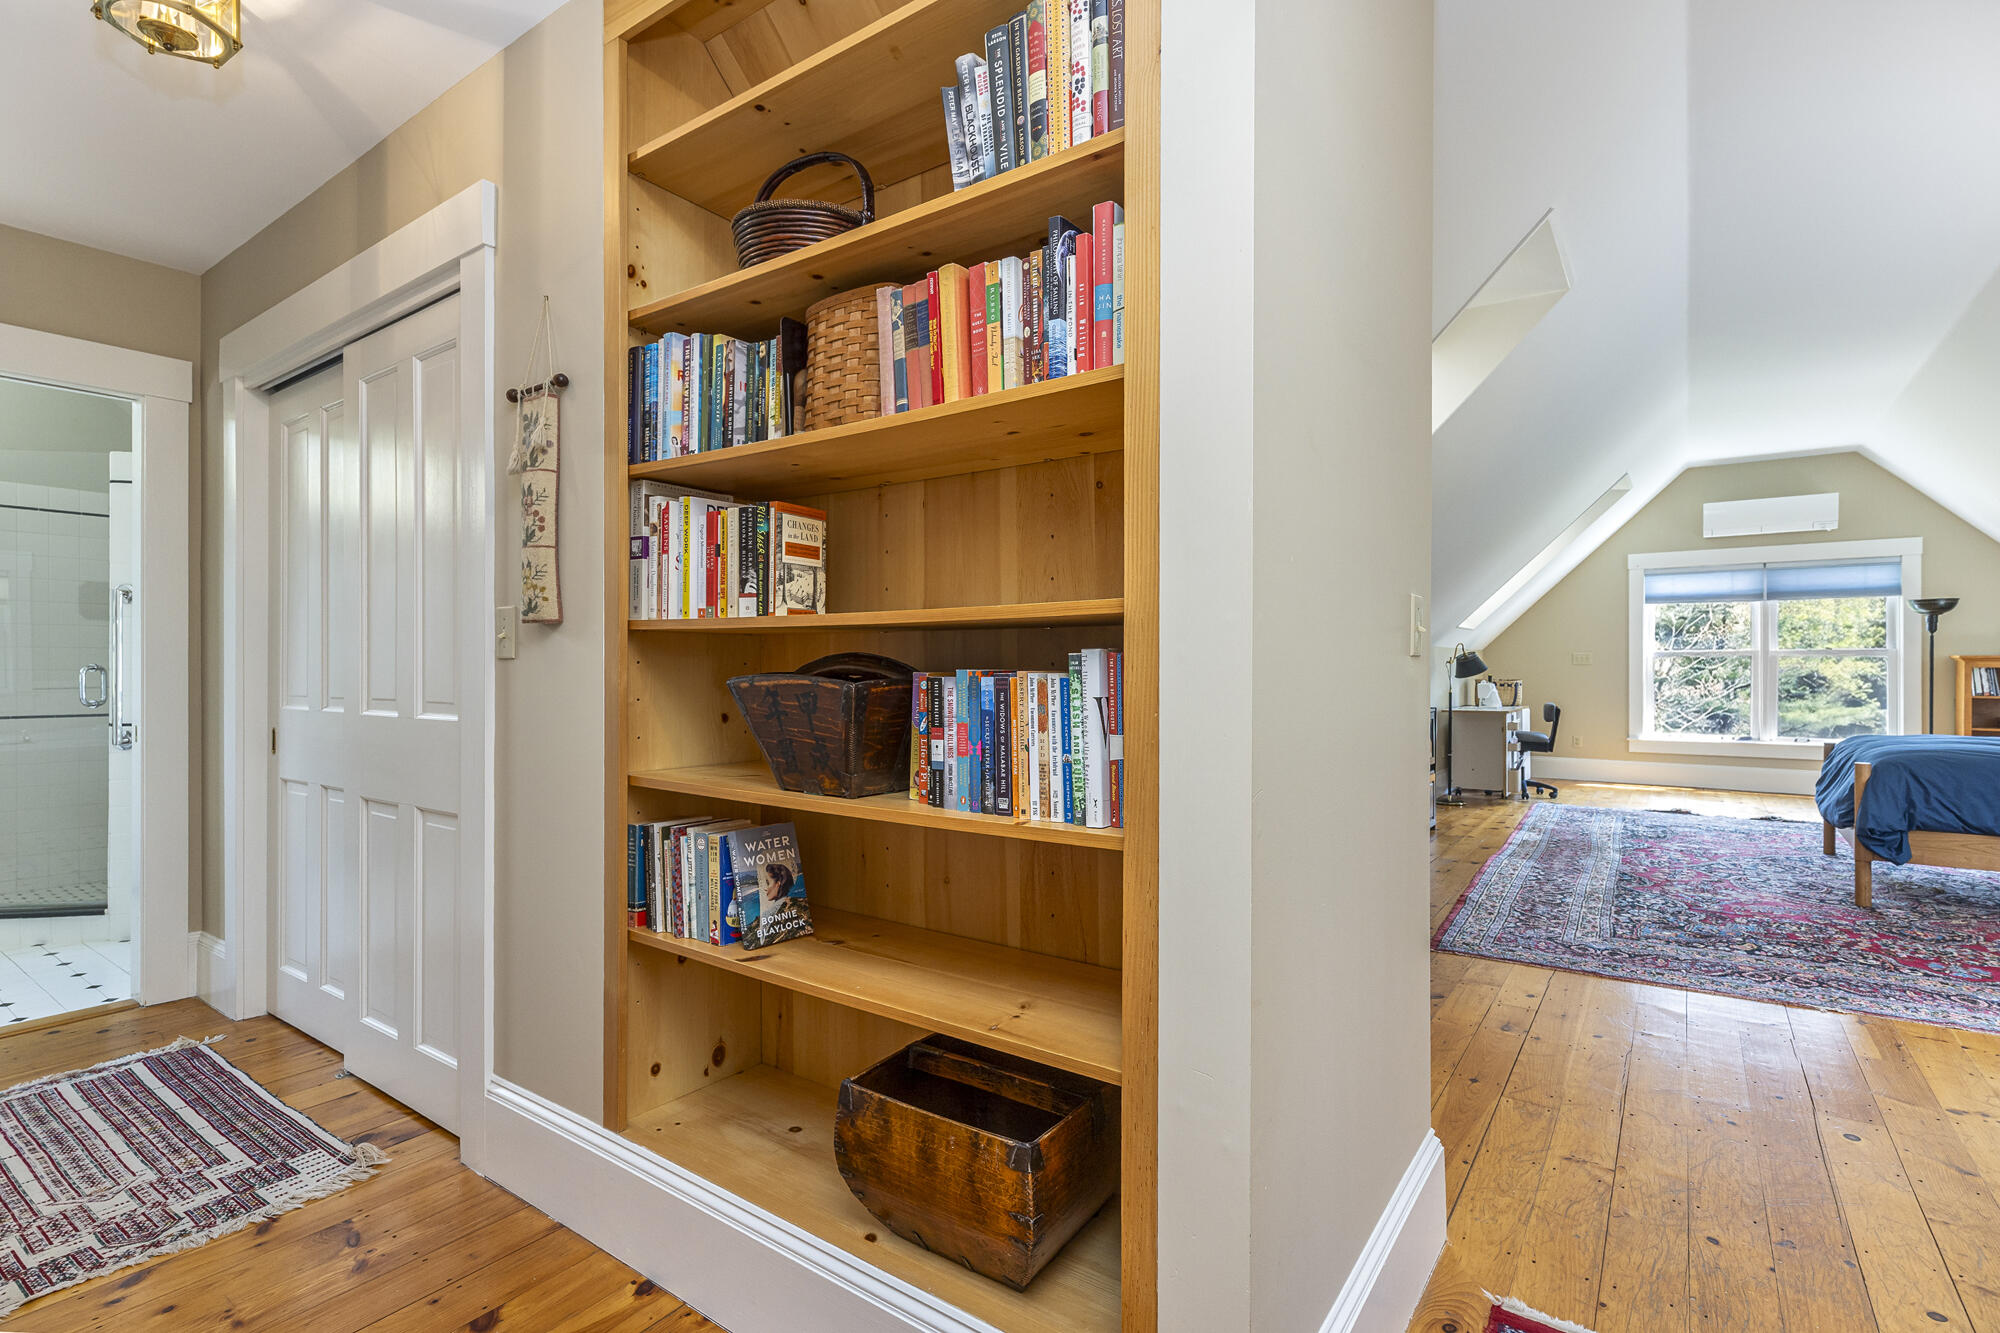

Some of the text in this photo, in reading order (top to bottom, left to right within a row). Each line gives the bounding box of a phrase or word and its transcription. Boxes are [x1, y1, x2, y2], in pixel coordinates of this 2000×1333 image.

[1014, 22, 1020, 30] IN
[1112, 9, 1123, 59] LOST ART
[988, 36, 1007, 46] LARSON
[961, 60, 970, 86] PETER
[1016, 77, 1022, 87] OF
[994, 59, 1006, 117] SPLENDID
[965, 104, 980, 176] BLACKHOUSE
[999, 143, 1009, 170] VILE
[1052, 276, 1059, 286] OF
[1097, 302, 1112, 310] JIN
[757, 506, 766, 554] RILEY SAGER
[787, 519, 820, 533] CHANGES
[800, 531, 819, 543] LAND
[946, 698, 954, 732] SNOWDONIA
[1070, 687, 1083, 793] SLASH AND BURN
[920, 738, 928, 782] Life of Pi
[745, 835, 790, 853] WATER
[743, 848, 795, 867] WOMEN
[735, 874, 743, 902] WOMEN
[761, 909, 798, 925] BONNIE
[756, 918, 806, 939] BLAYLOCK
